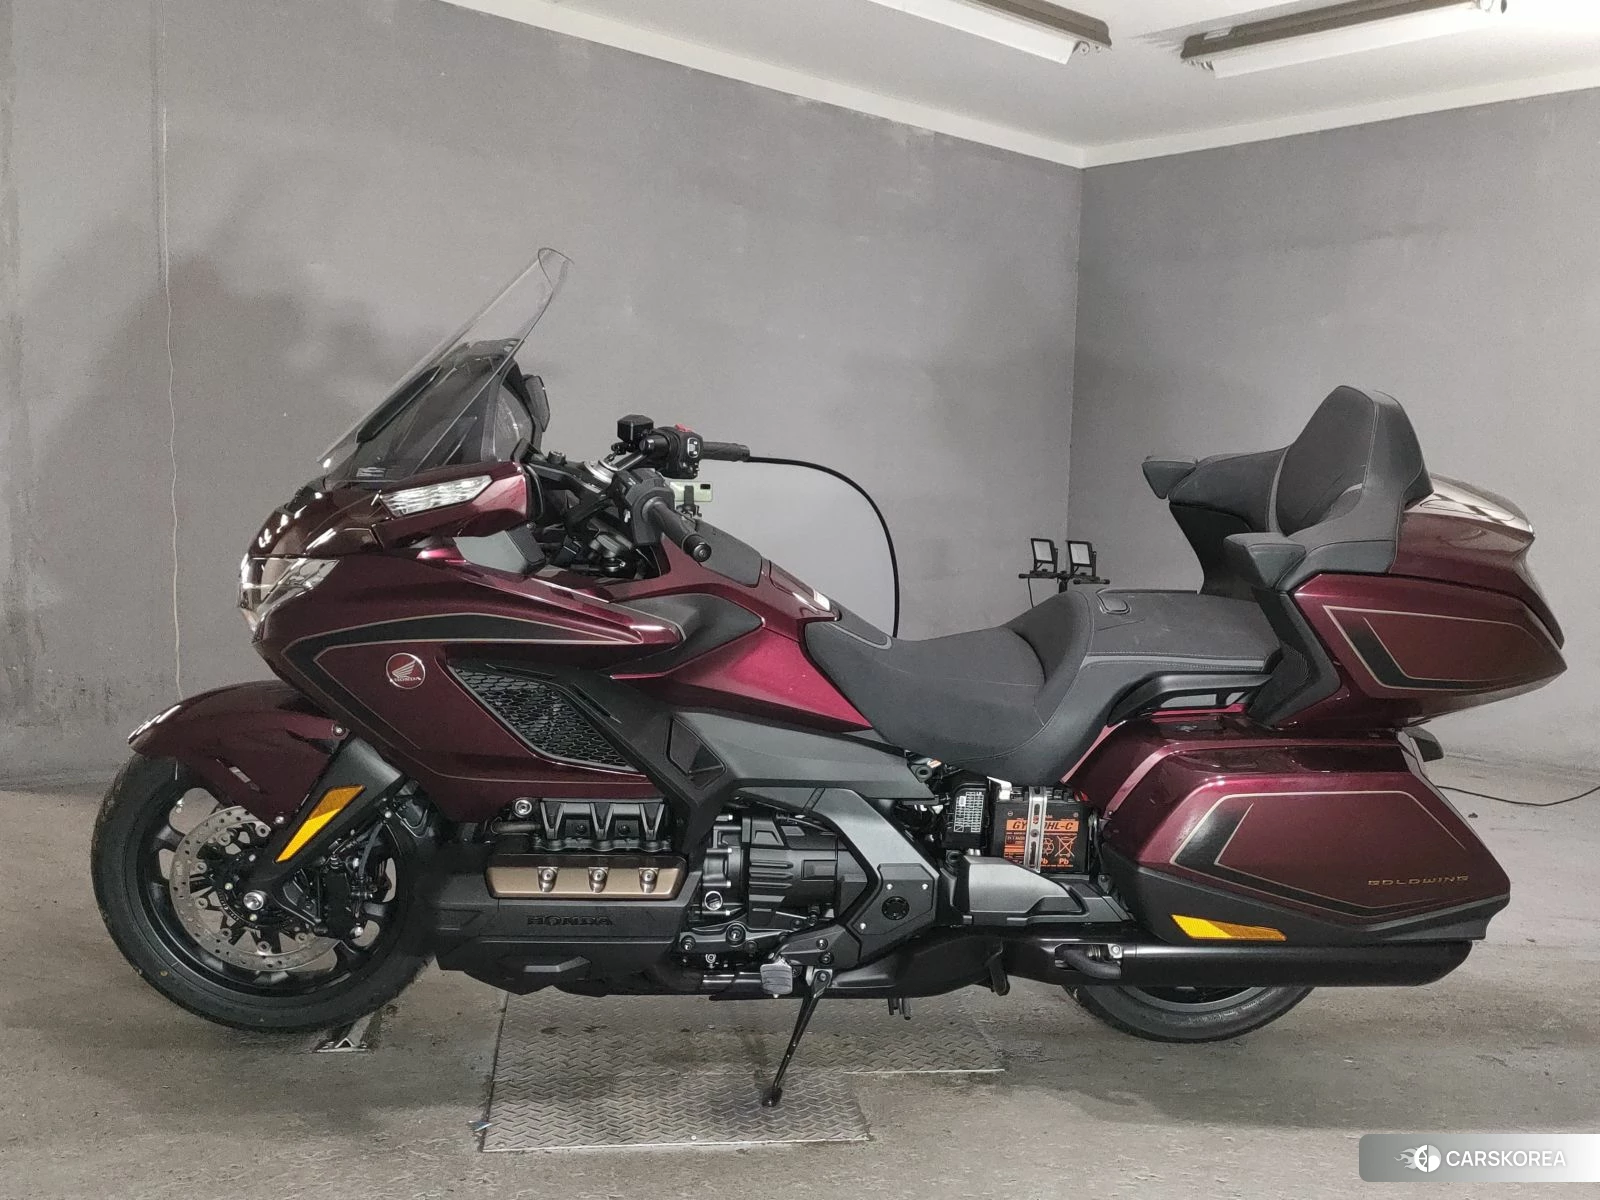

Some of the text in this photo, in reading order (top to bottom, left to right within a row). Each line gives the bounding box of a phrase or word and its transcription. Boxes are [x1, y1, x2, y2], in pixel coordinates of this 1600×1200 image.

[1013, 821, 1073, 831] GYHL-C
[1059, 857, 1069, 865] Pb
[1367, 875, 1469, 886] GOLDWING
[526, 915, 613, 926] HONDA
